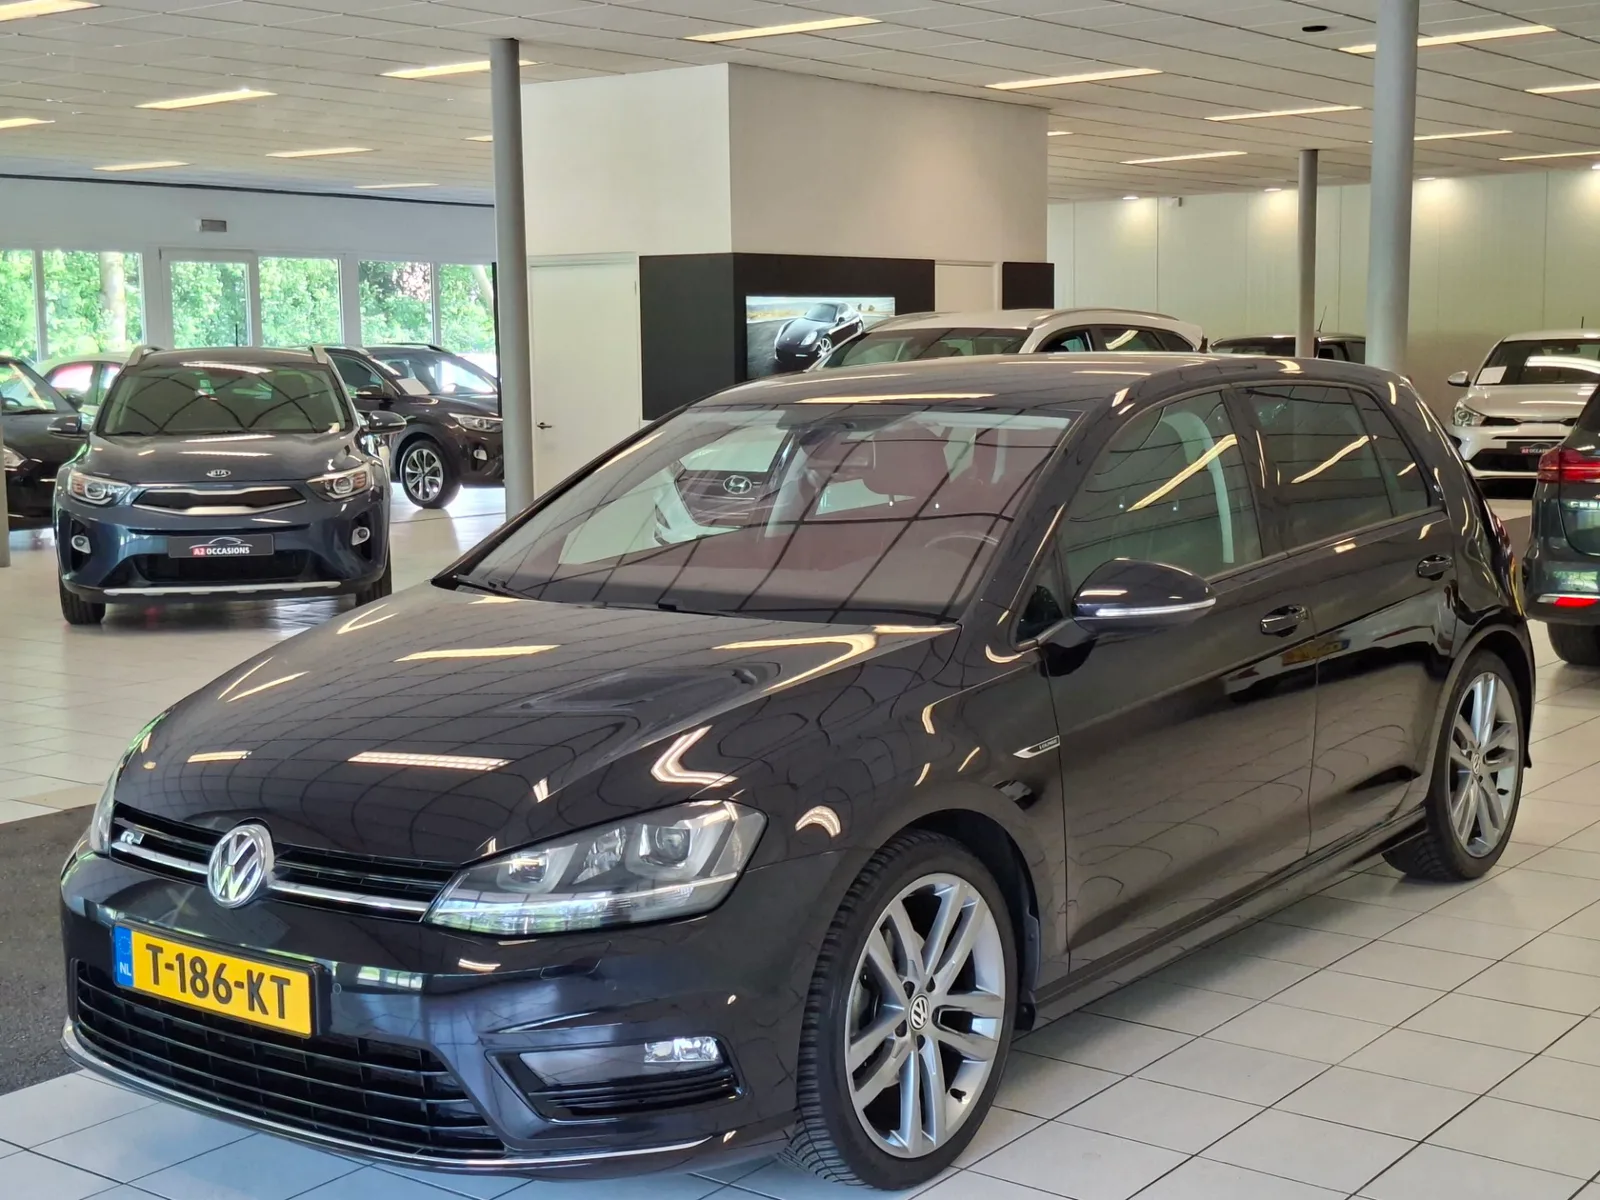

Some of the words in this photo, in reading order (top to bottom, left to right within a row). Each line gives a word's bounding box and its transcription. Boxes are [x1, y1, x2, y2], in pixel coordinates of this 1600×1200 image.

[193, 548, 205, 556] A2
[206, 547, 250, 556] OCCASIONS
[119, 961, 132, 977] NL
[145, 943, 291, 1020] T-186-KT
